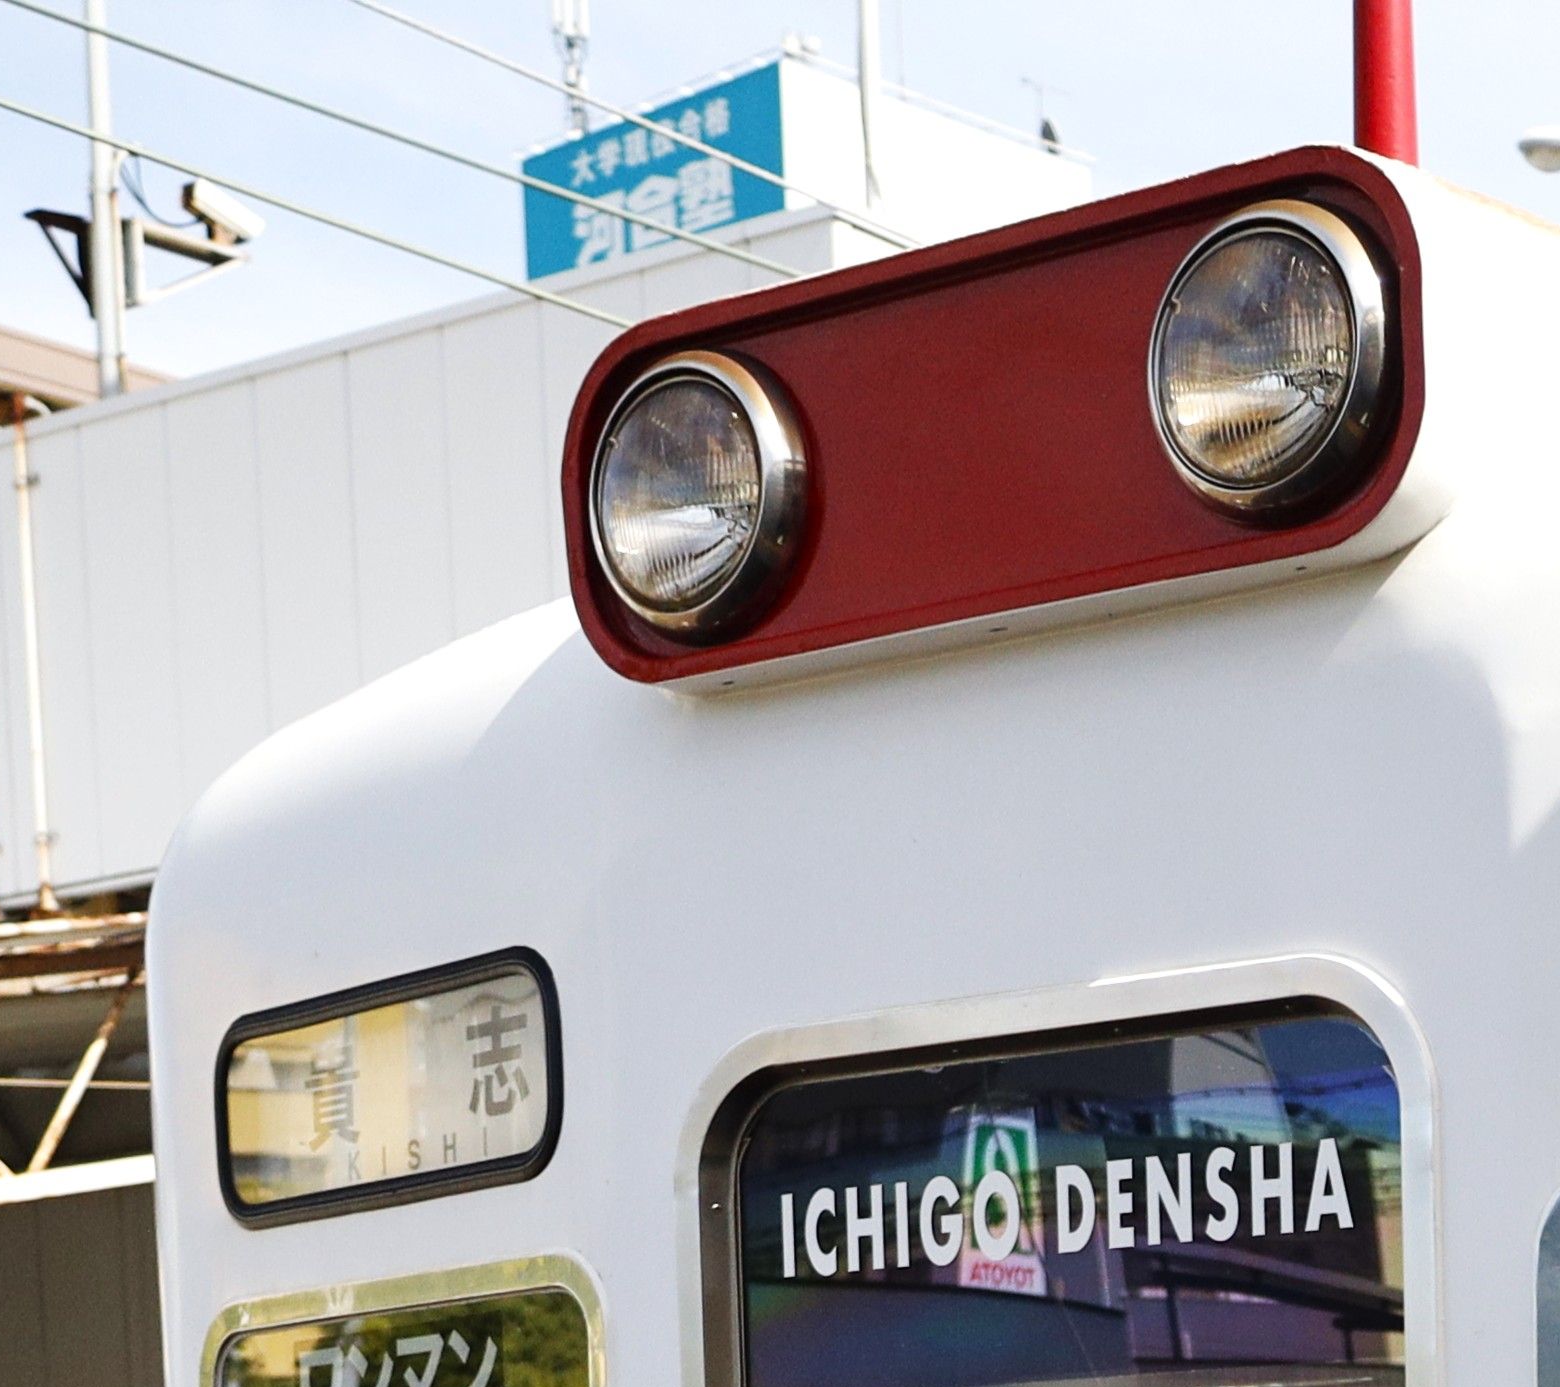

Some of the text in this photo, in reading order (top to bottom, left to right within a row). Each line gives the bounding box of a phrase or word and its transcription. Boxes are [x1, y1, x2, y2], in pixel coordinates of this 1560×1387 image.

[348, 1126, 487, 1180] KISHI
[780, 1137, 1354, 1277] ICHIGO DENSHA
